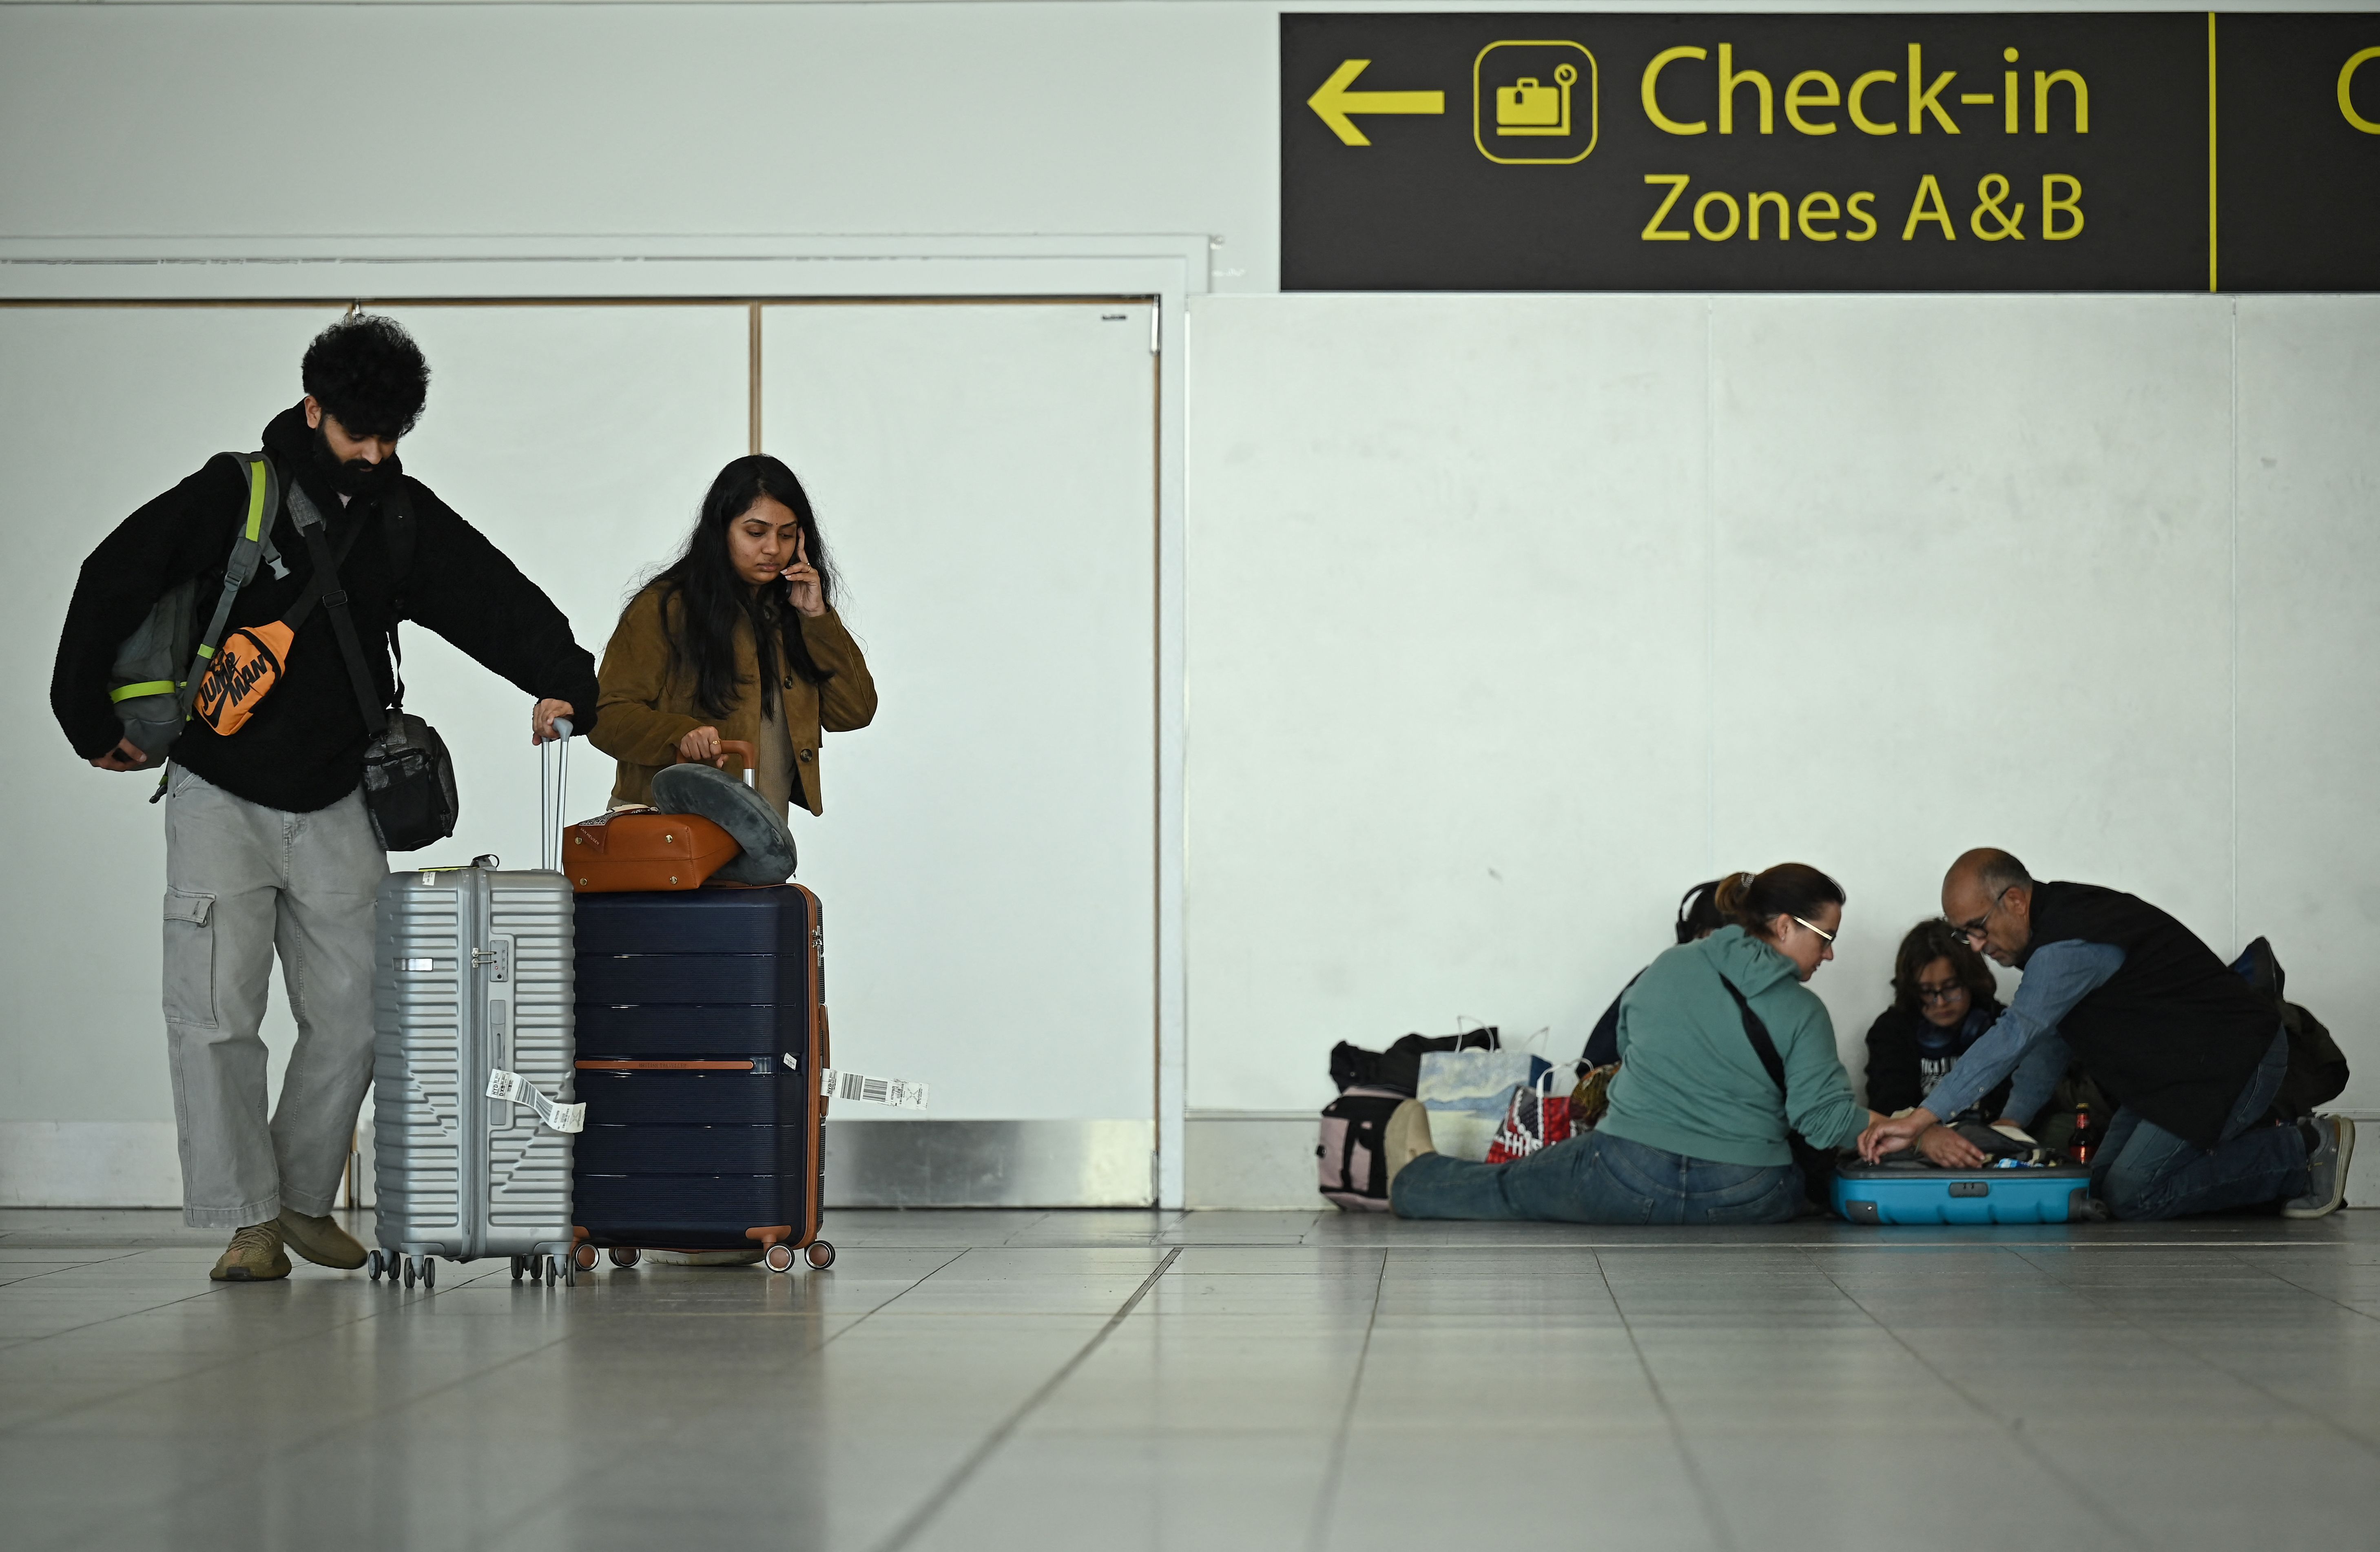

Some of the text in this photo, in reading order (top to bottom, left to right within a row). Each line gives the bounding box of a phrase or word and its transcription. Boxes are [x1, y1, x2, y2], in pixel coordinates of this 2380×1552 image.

[1642, 43, 2088, 135] Check-in
[1642, 175, 1877, 241] Zones
[229, 653, 267, 707] MAN
[586, 832, 600, 845] HEUSEN
